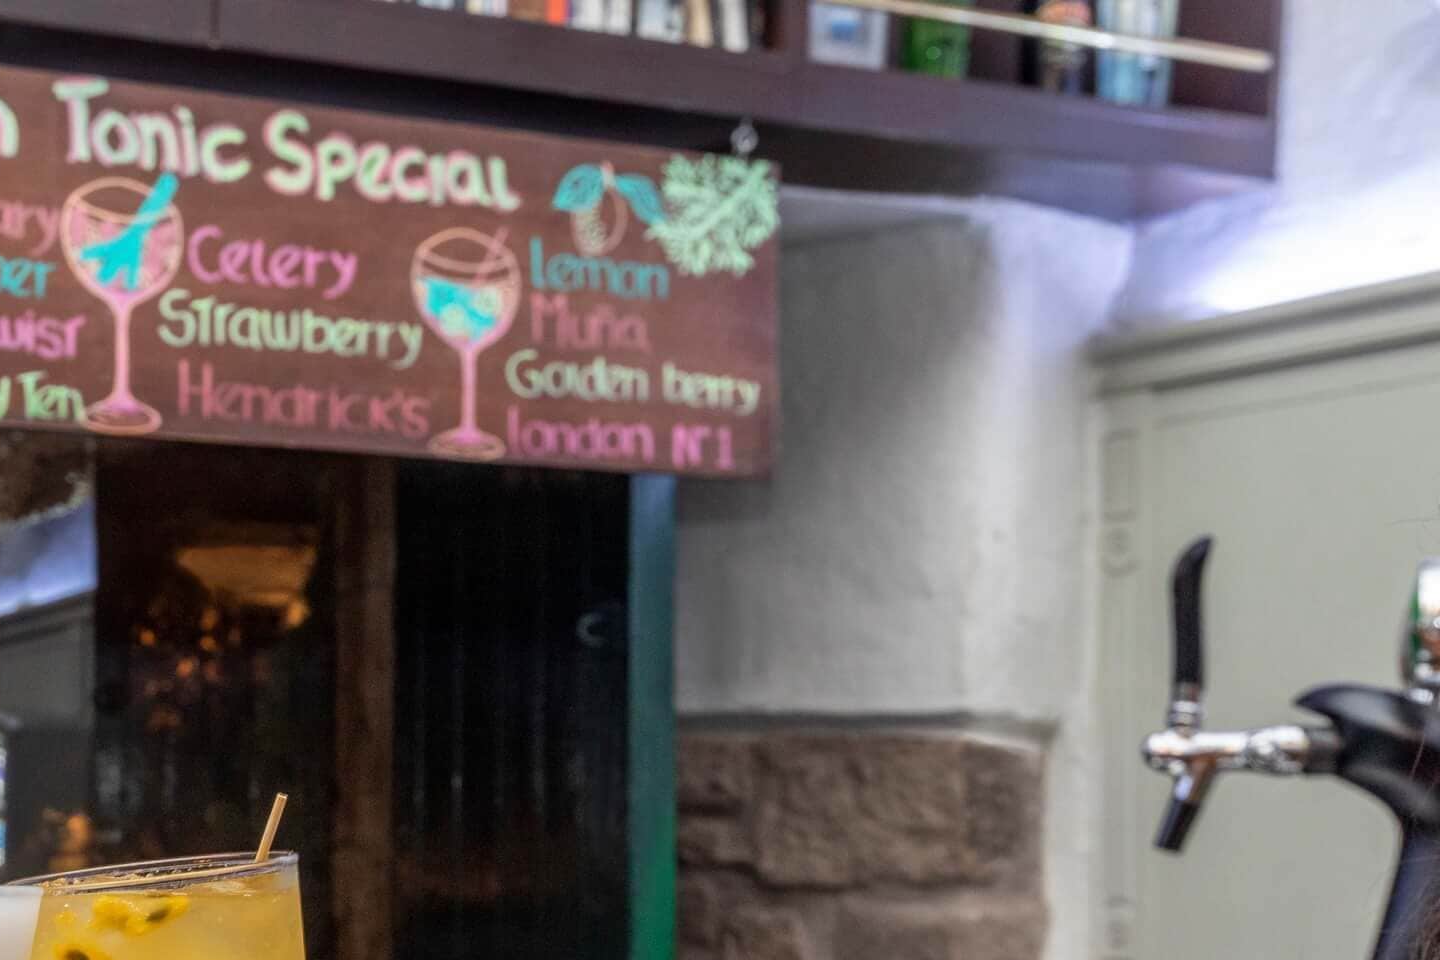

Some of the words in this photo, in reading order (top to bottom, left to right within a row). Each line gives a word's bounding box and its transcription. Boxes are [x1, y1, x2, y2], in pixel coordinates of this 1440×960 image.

[52, 79, 251, 182] Tonic
[263, 110, 521, 210] Special
[188, 226, 357, 299] Celery
[158, 289, 423, 369] Strawberry
[18, 371, 86, 423] Ten
[663, 361, 760, 416] berry
